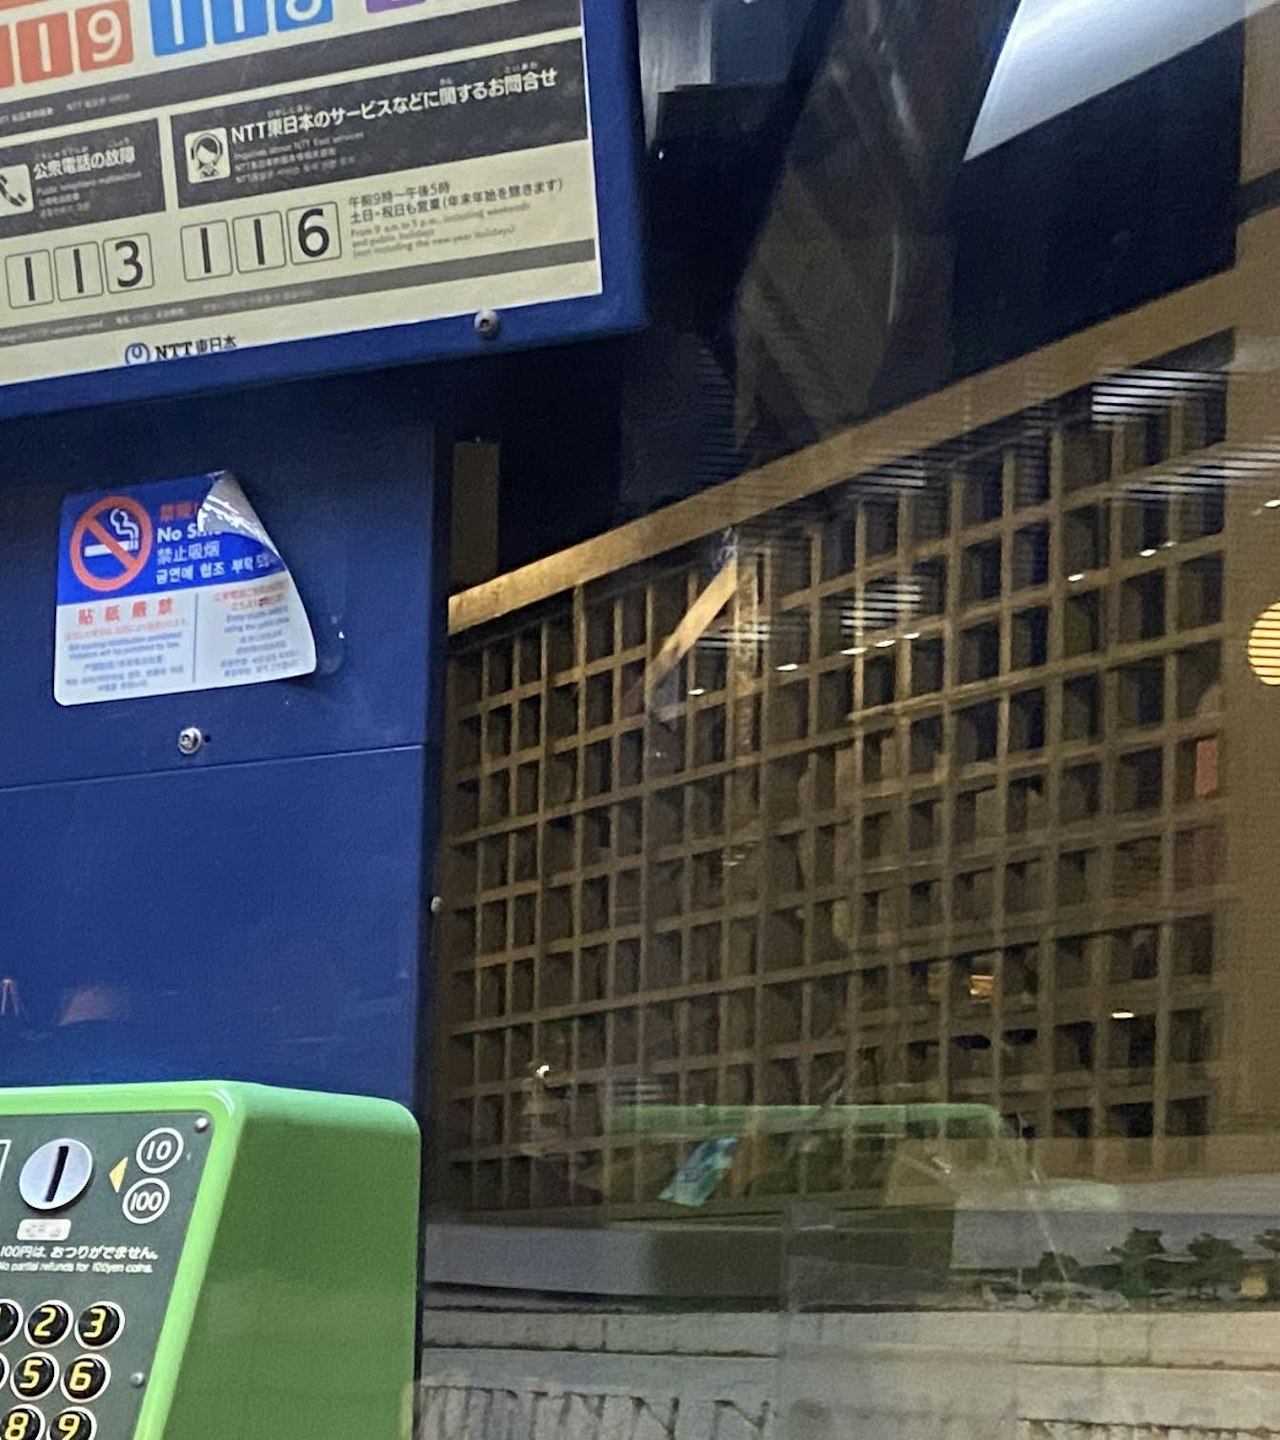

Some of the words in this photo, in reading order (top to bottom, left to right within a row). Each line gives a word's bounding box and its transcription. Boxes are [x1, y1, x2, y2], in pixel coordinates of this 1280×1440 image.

[231, 67, 557, 144] NTT東日本のサービスなどに関するお問合せ
[200, 208, 330, 274] 116
[25, 240, 143, 301] 113
[157, 527, 182, 543] No
[147, 1141, 171, 1161] 10
[130, 1192, 162, 1211] 100
[34, 1307, 56, 1337] 2
[83, 1308, 106, 1338] 3
[19, 1360, 43, 1389] 5
[69, 1361, 94, 1391] 6
